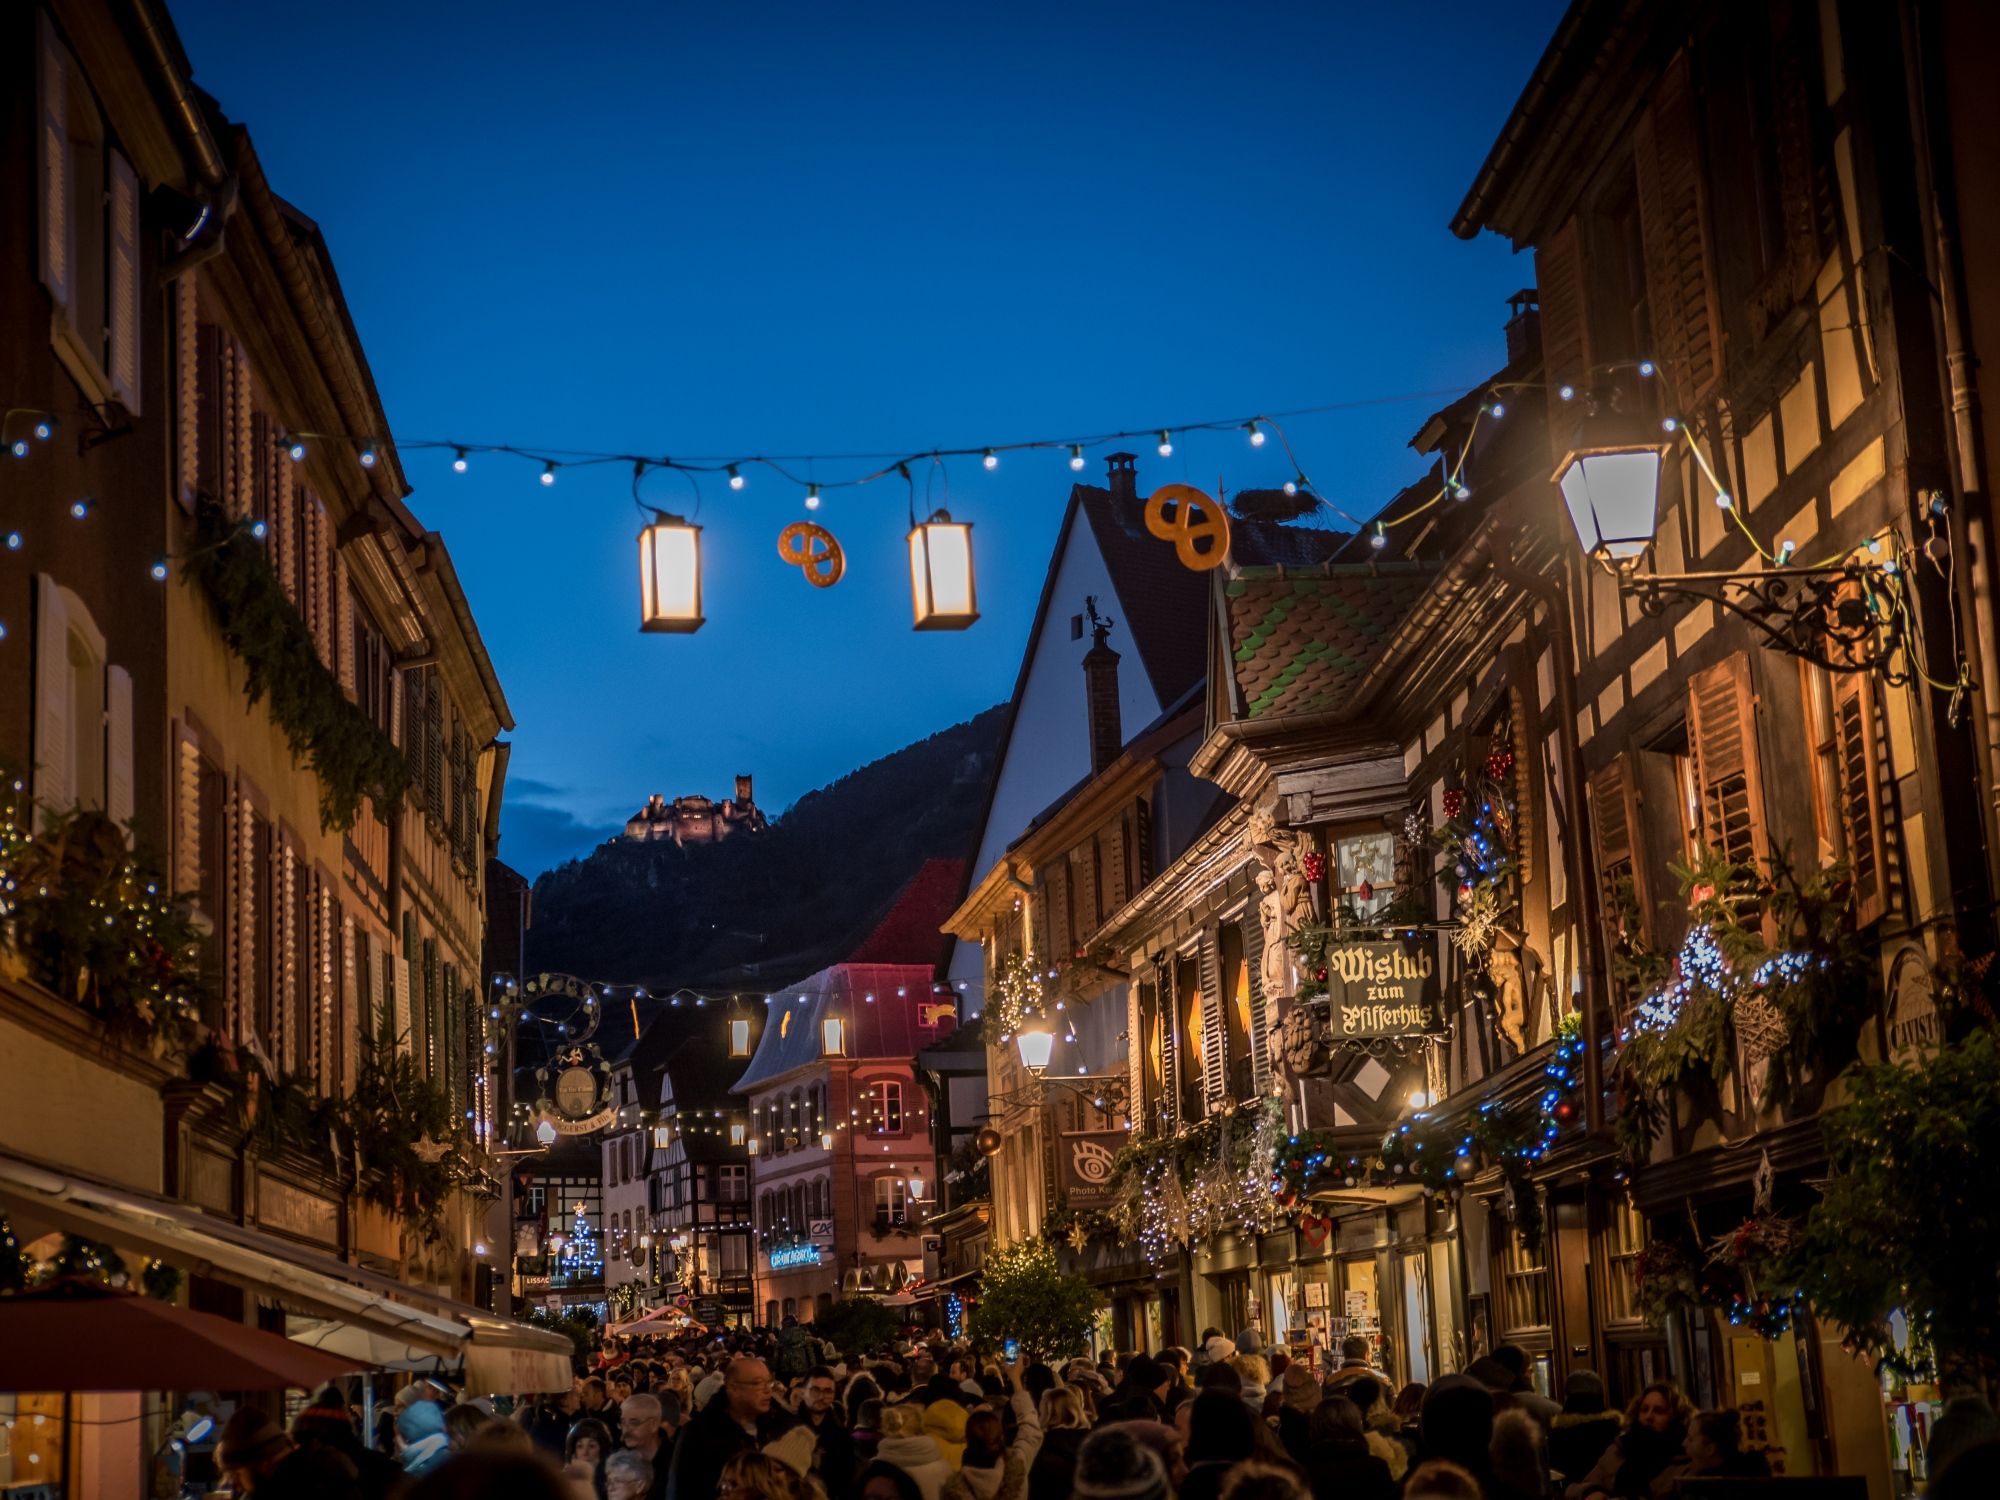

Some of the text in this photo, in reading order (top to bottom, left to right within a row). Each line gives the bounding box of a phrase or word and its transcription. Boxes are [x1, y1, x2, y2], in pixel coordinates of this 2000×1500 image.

[1332, 947, 1432, 984] Wistub
[1366, 985, 1404, 1000] zum
[1070, 1186, 1095, 1195] Photo
